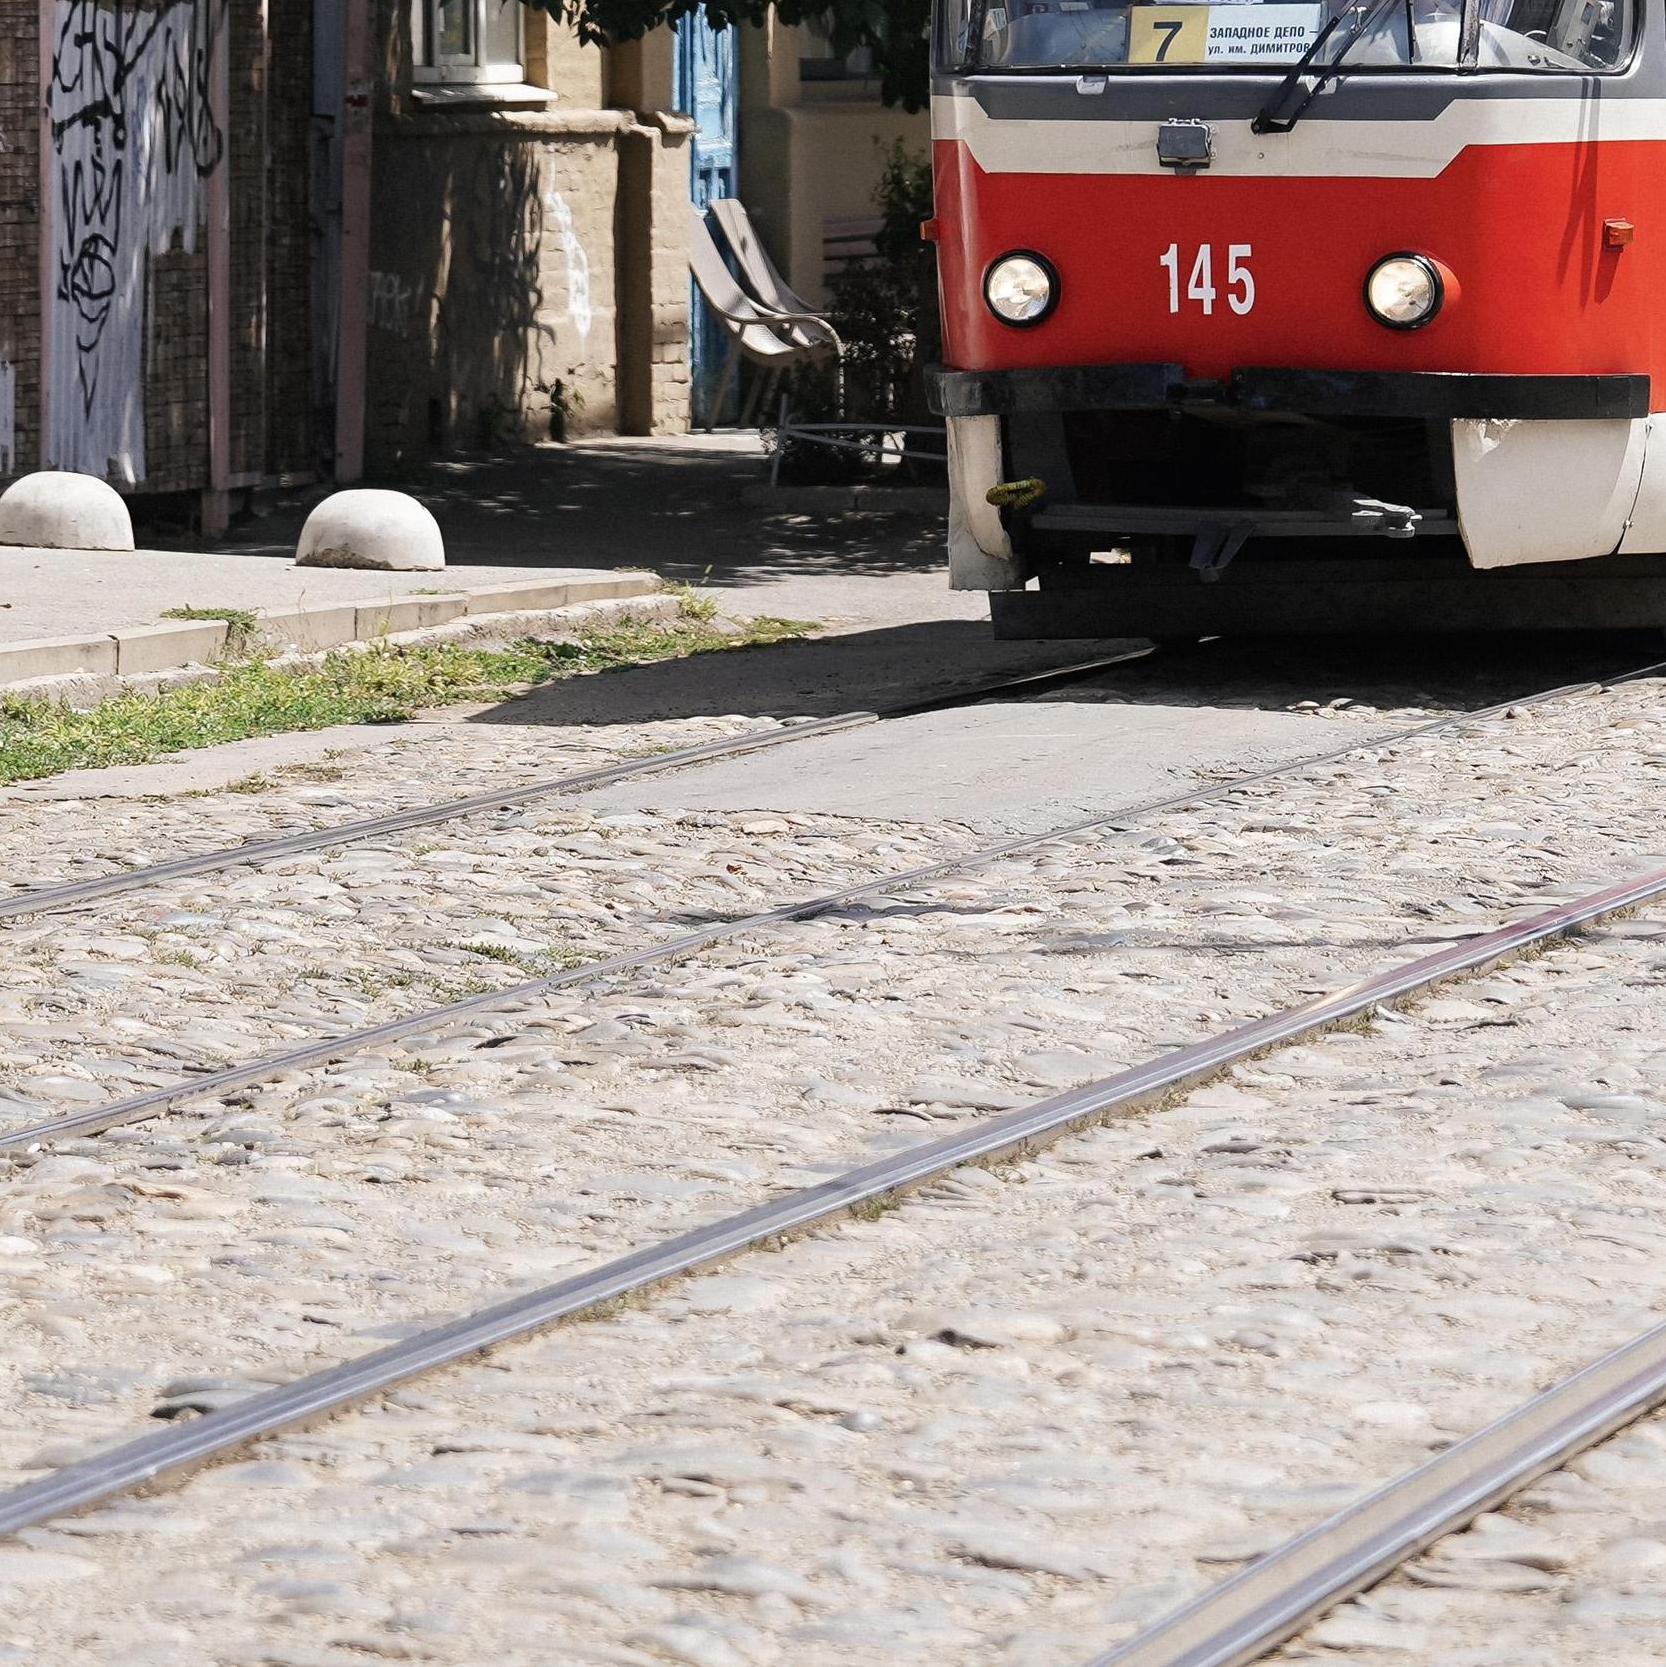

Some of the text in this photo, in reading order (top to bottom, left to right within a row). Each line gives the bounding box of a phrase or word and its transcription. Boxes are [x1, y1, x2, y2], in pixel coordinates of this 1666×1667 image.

[1152, 21, 1183, 62] 7
[1209, 26, 1270, 42] ЗАПАДНОЕ
[1273, 25, 1305, 40] ДЕПО
[1228, 45, 1247, 54] им.
[1159, 243, 1255, 315] 145
